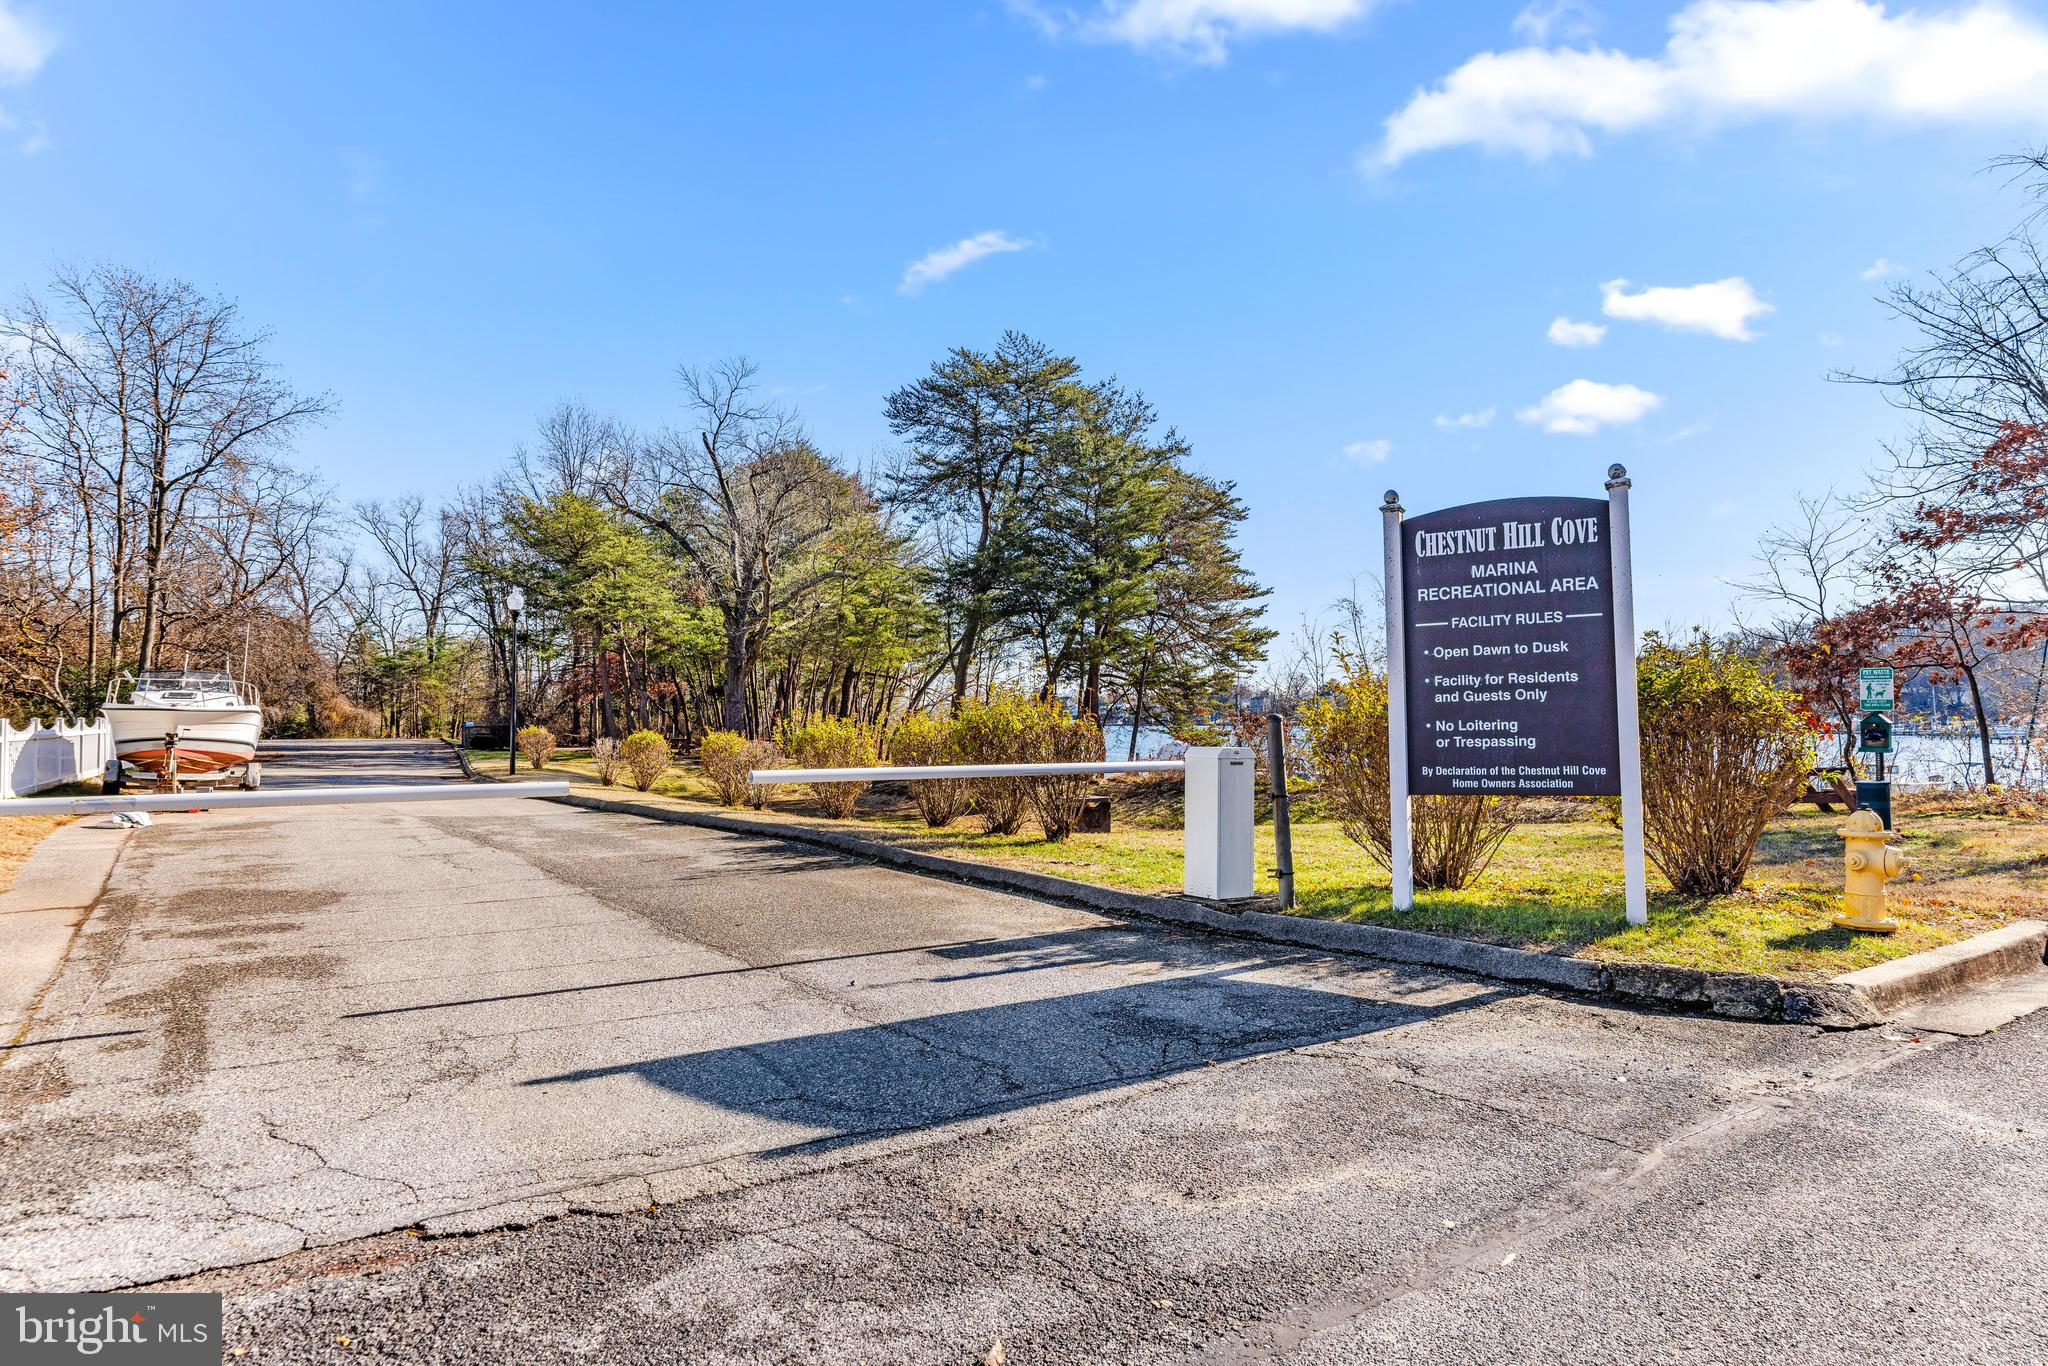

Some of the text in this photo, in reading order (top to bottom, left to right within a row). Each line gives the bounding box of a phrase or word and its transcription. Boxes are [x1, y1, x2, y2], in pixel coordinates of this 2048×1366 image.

[1415, 517, 1598, 557] CHESTNUT HILL COVE
[1471, 561, 1538, 578] MARINA
[1418, 577, 1598, 601] RECREATIONAL AREA
[1452, 611, 1563, 628] FACILITY RULES
[1433, 641, 1568, 660] Open Dawn to Dusk
[1435, 671, 1578, 688] Facility for Residents
[1435, 689, 1547, 702] and Guests Only
[1436, 720, 1517, 732] No Loitering
[1436, 736, 1535, 749] or Trespassing
[1423, 766, 1606, 777] By Declaration of the Chestnut Hill Cove
[1453, 779, 1573, 788] Home Owners Association
